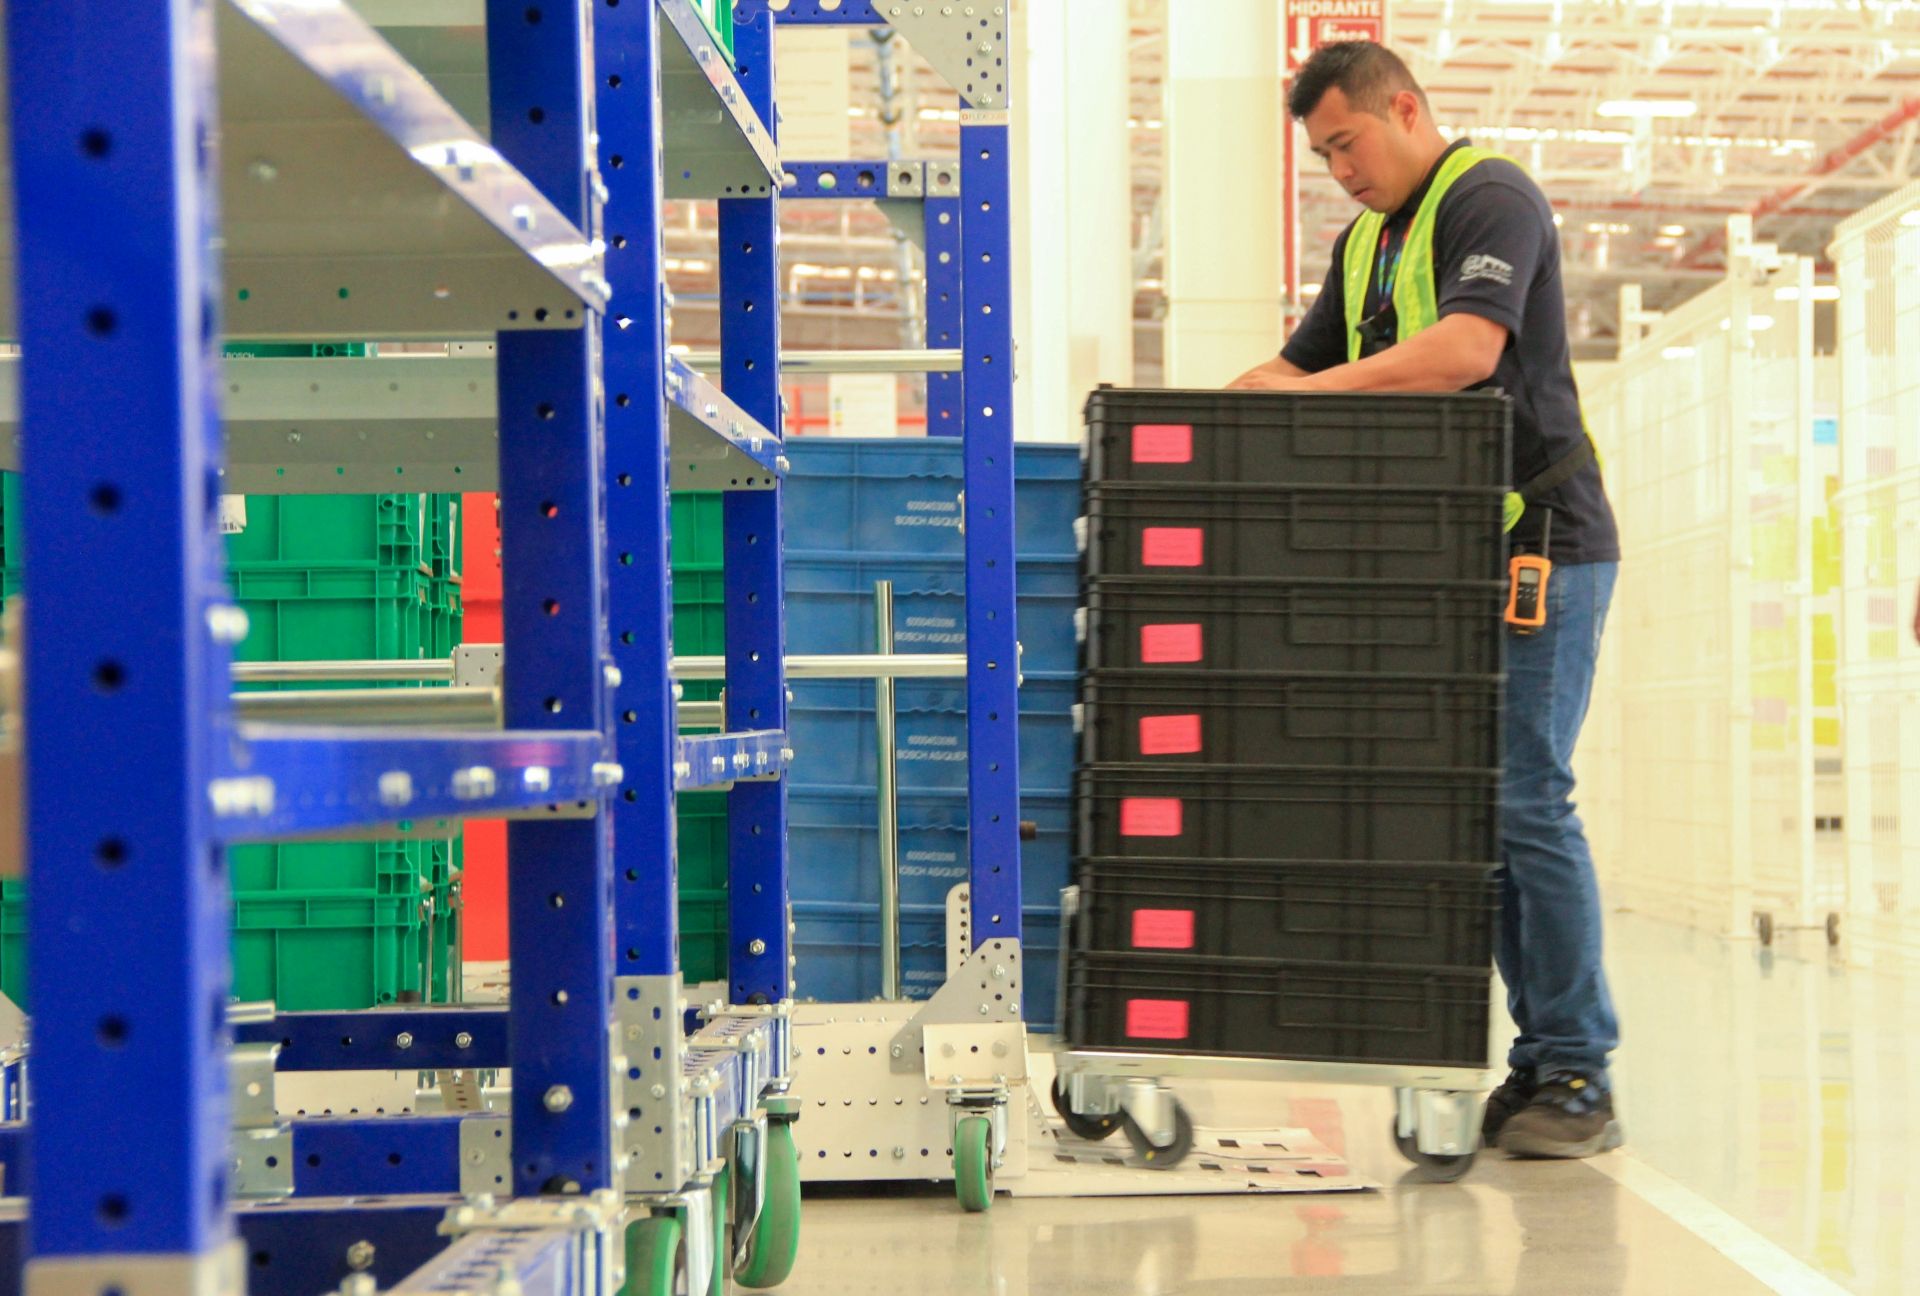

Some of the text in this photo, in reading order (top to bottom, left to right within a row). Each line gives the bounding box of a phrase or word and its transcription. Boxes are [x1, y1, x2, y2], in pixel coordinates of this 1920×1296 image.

[1288, 0, 1380, 16] HIDRANTE
[895, 515, 926, 525] BOSCH
[894, 631, 926, 642] BOSCH
[896, 749, 928, 760] BOSCH
